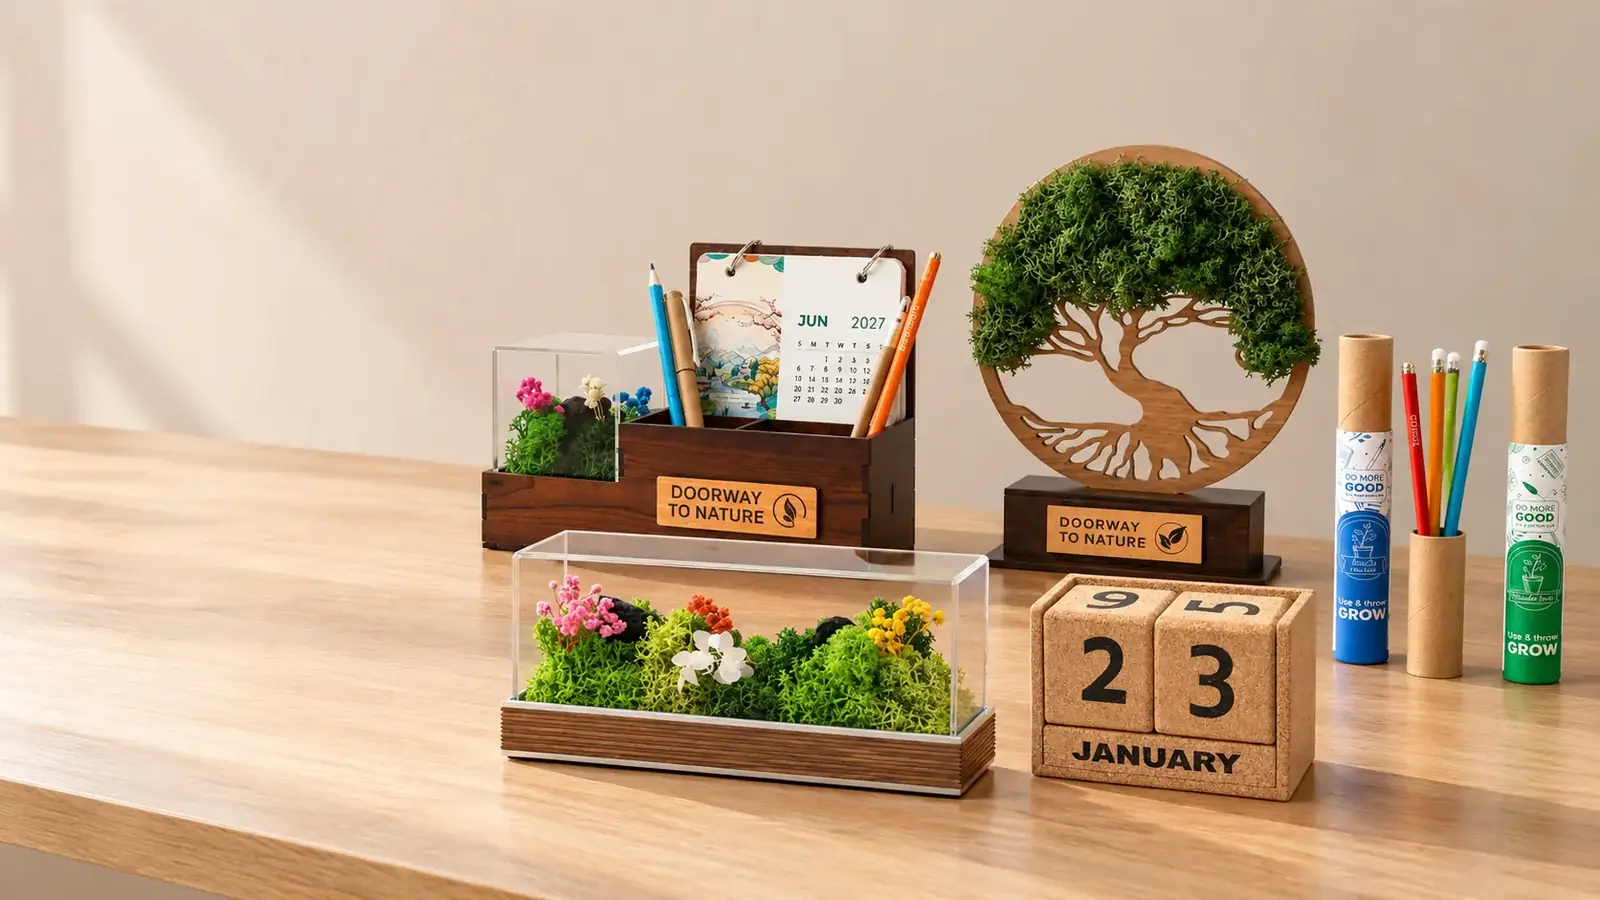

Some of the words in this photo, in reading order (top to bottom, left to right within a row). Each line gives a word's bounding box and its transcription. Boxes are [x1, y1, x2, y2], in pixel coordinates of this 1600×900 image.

[798, 315, 828, 327] JUN
[852, 317, 885, 329] 2027
[793, 385, 802, 393] 20
[820, 386, 829, 394] 22
[1360, 474, 1384, 482] MORE
[672, 485, 762, 505] DOORWAY
[1345, 483, 1384, 492] GOOD
[668, 503, 690, 518] TO
[696, 506, 764, 524] NATURE
[1516, 512, 1554, 522] GOOD
[1060, 517, 1140, 532] DOORWAY
[1059, 532, 1079, 543] TO
[1084, 533, 1146, 548] NATURE
[1184, 600, 1260, 616] 5
[1337, 596, 1353, 606] Use
[1338, 607, 1386, 621] GROW
[1508, 641, 1558, 656] GROW
[1082, 636, 1127, 704] 2
[1189, 644, 1235, 719] 3
[1072, 741, 1240, 774] JANUARY
